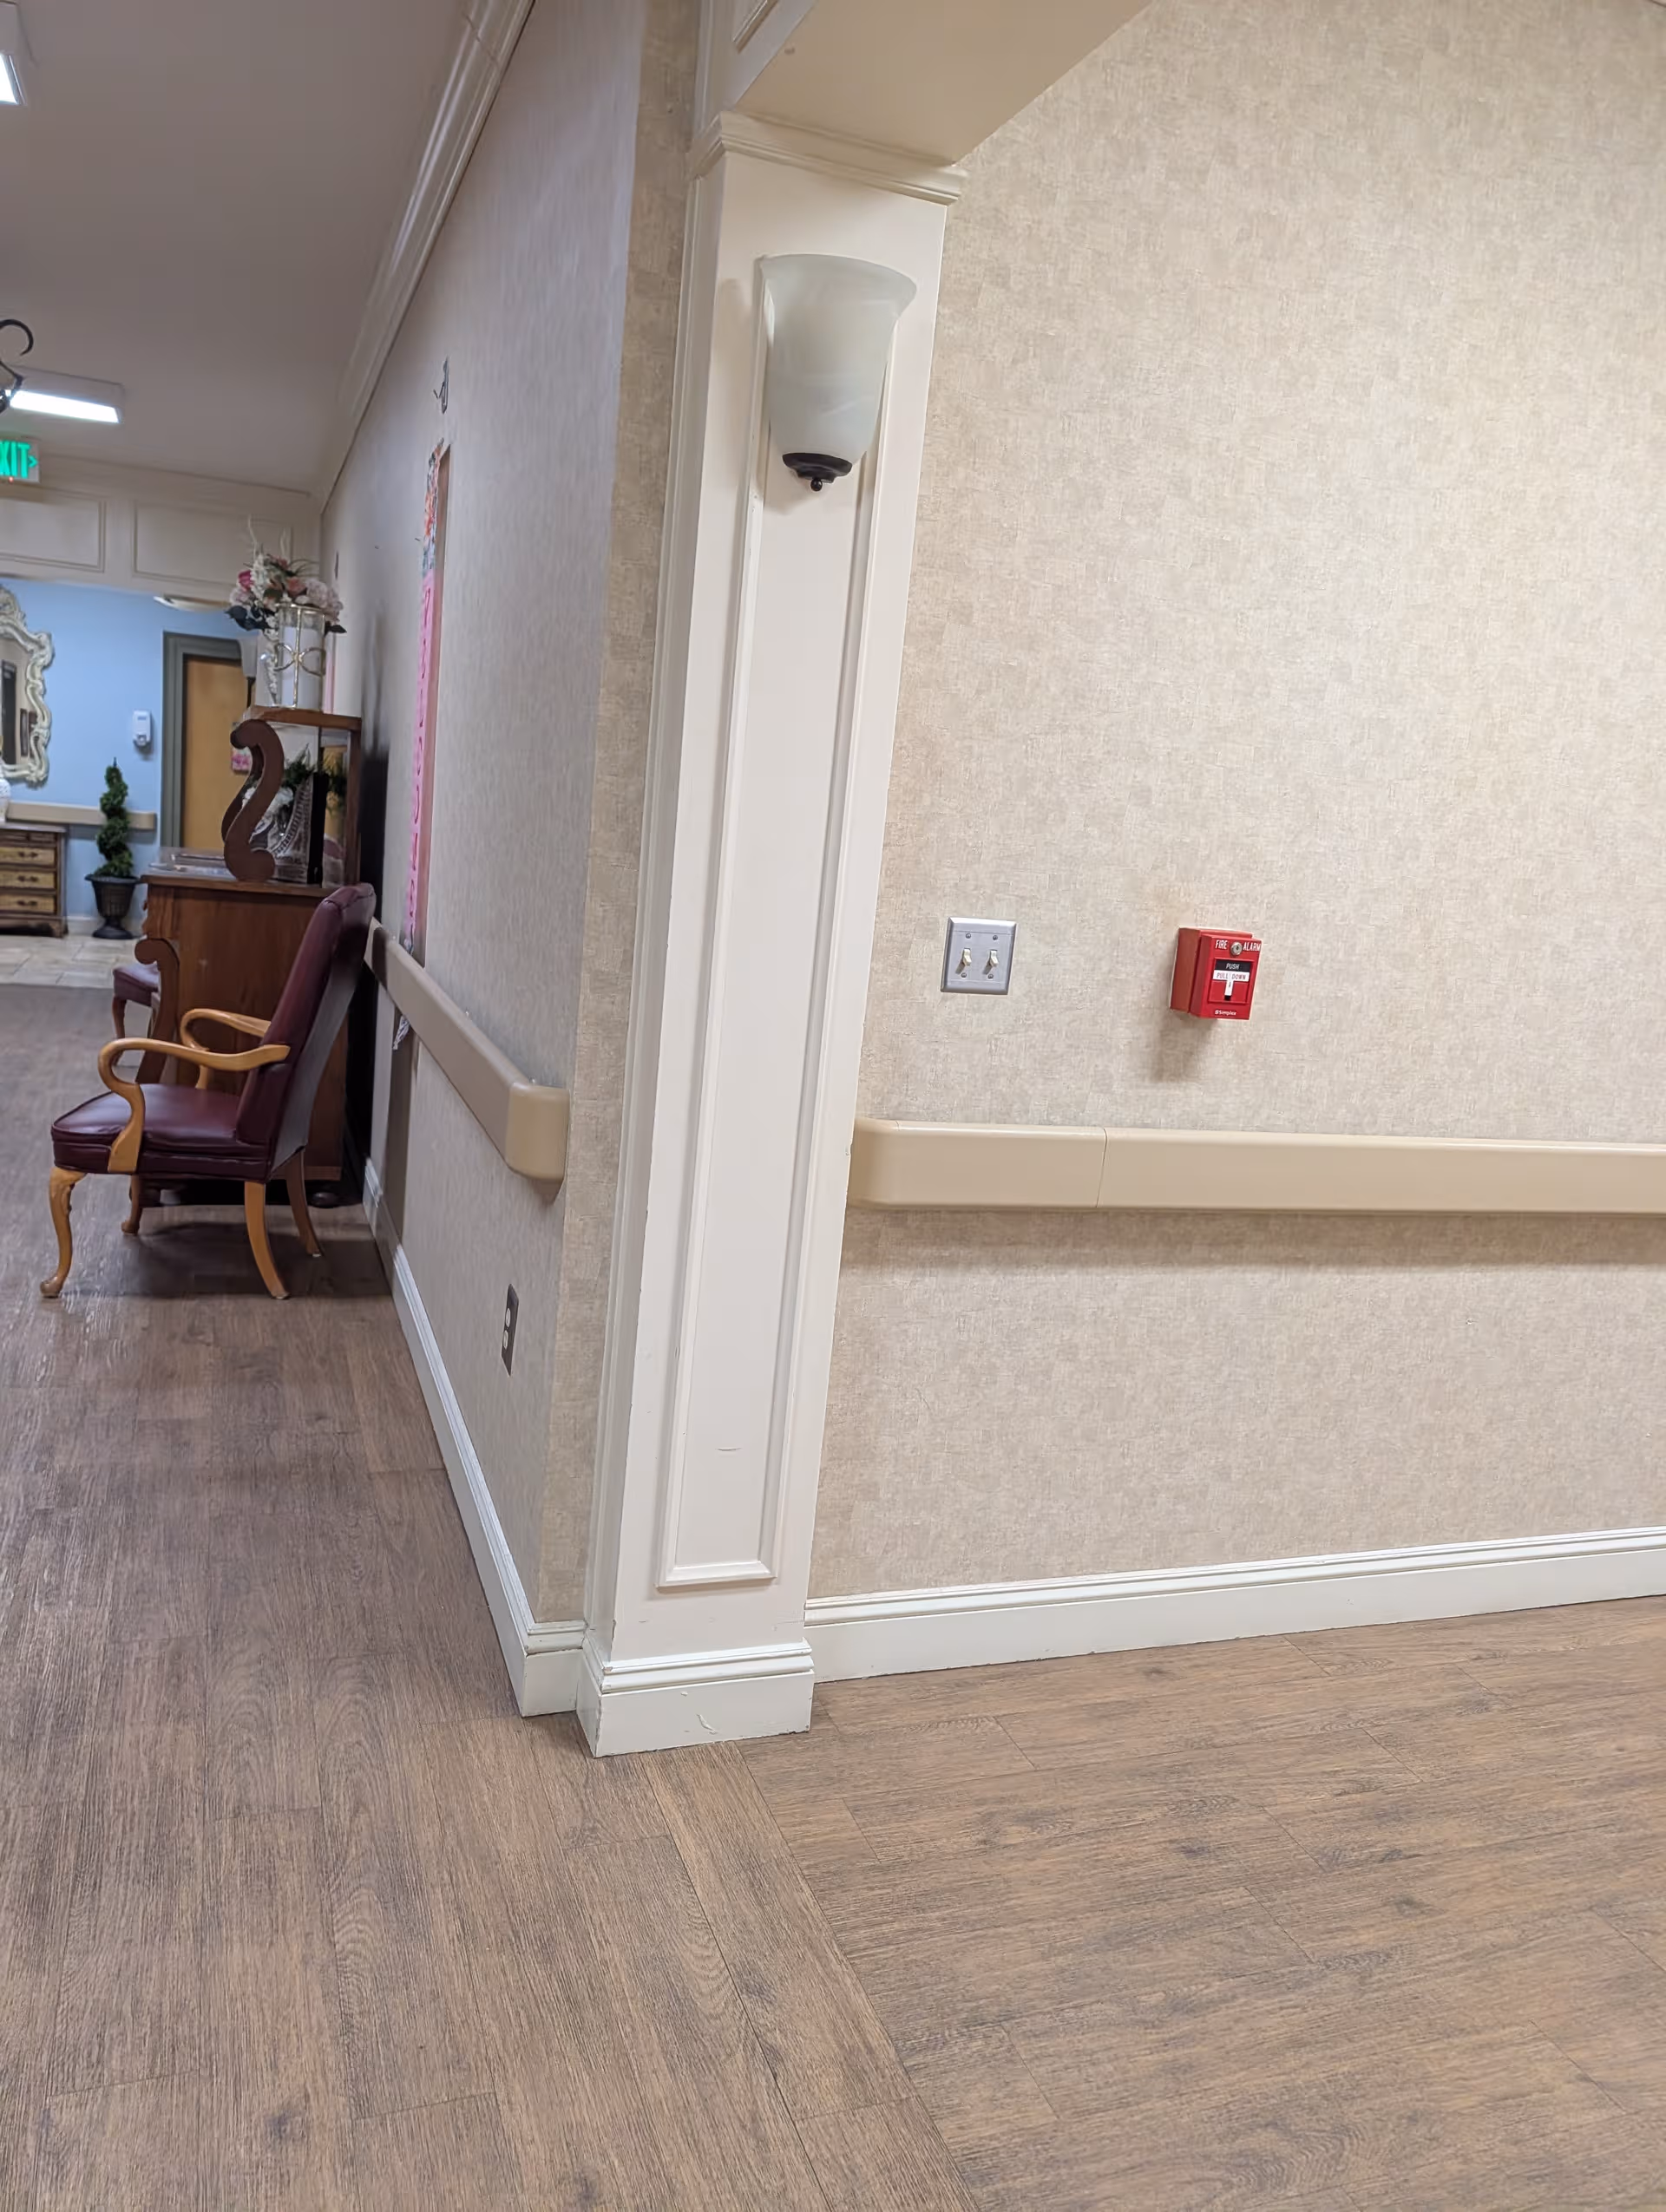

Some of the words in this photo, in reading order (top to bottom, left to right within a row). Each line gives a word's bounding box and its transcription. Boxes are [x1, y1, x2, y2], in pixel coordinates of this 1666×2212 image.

[0, 440, 30, 478] XIT
[1215, 939, 1228, 950] FIRE
[1243, 942, 1262, 952] ALARM
